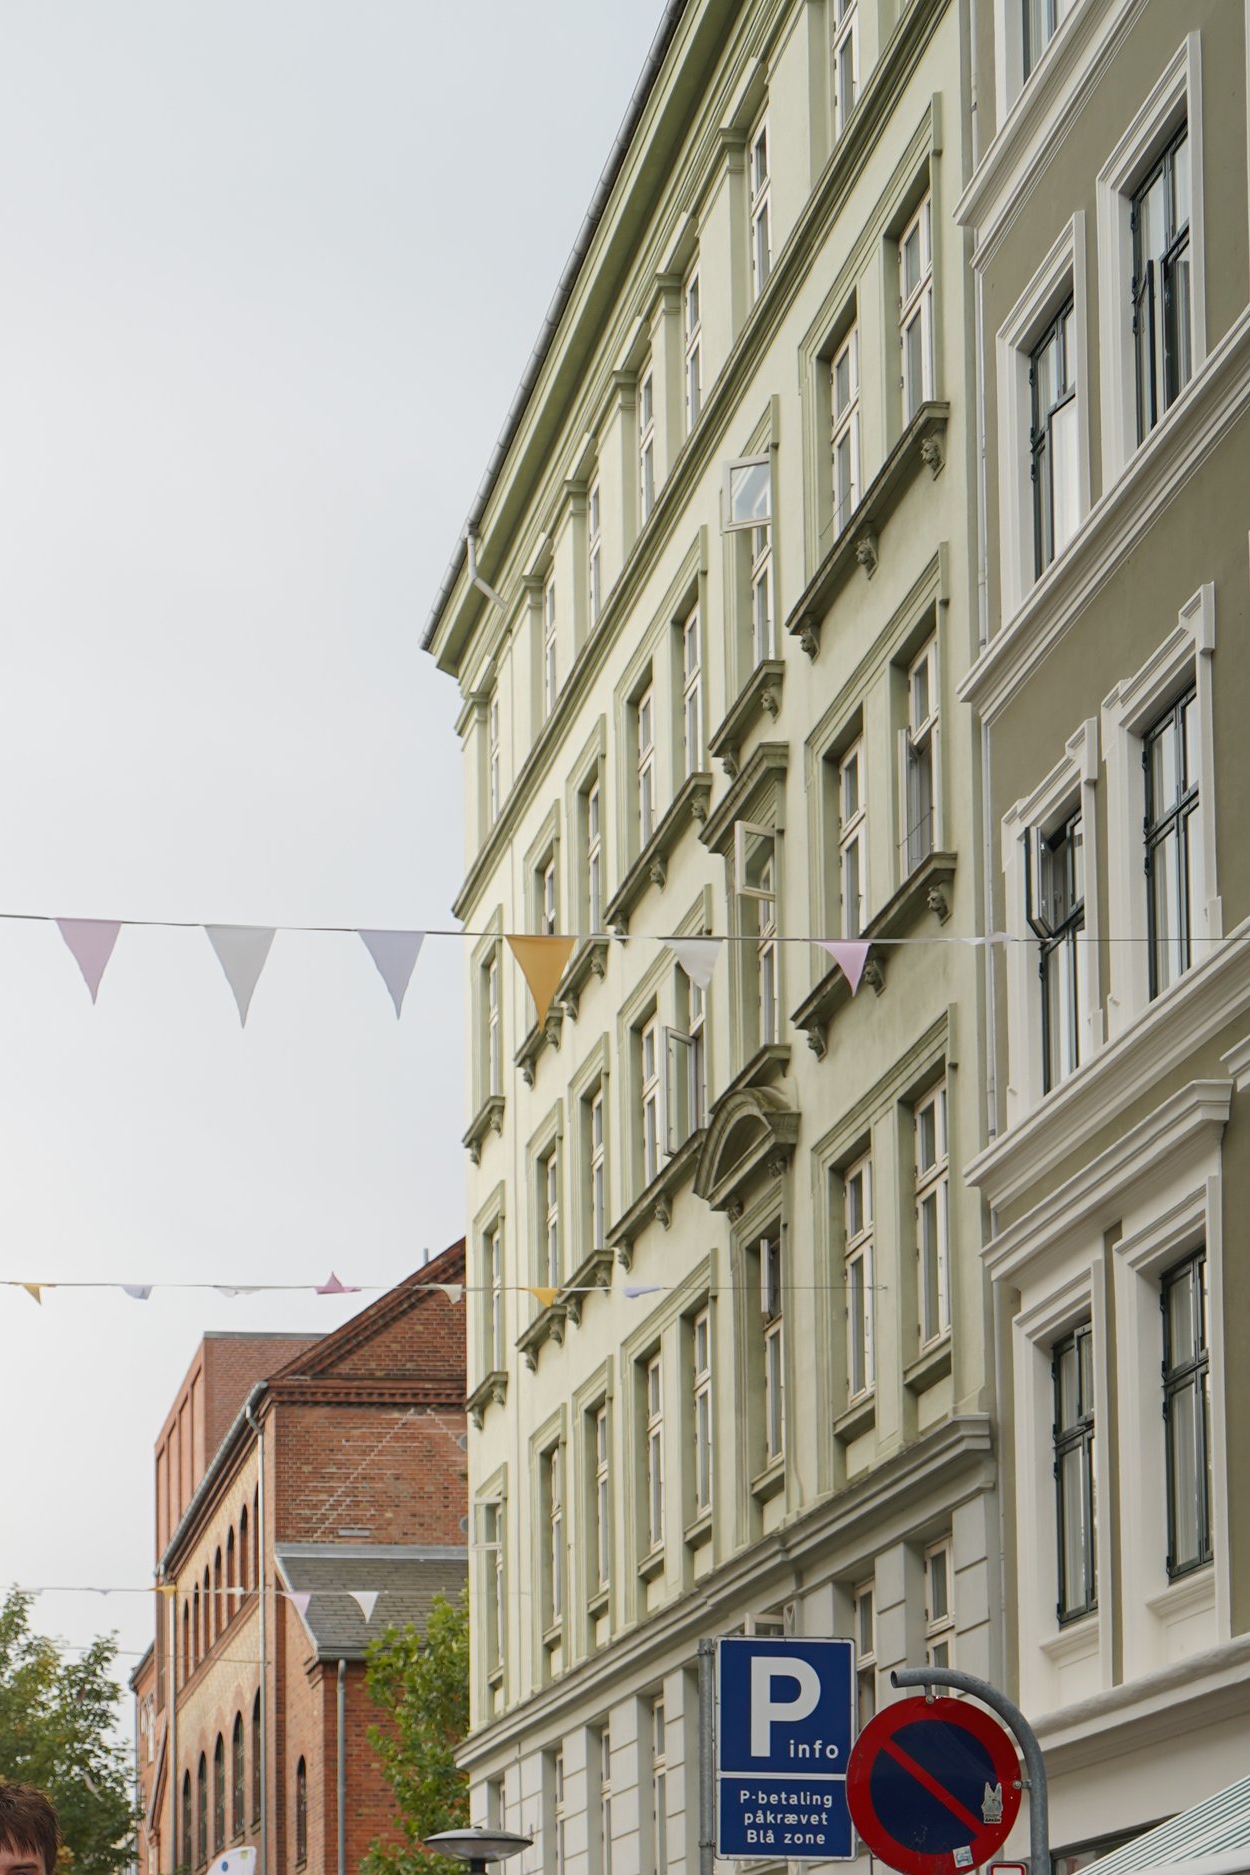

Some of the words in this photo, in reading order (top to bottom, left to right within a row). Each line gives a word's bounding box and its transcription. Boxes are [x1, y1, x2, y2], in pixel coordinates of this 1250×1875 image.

[751, 1656, 821, 1757] P
[789, 1740, 839, 1759] info
[740, 1790, 833, 1808] P-betaling
[744, 1810, 828, 1826] påkrævet
[747, 1829, 775, 1844] Blå
[784, 1833, 826, 1845] zone
